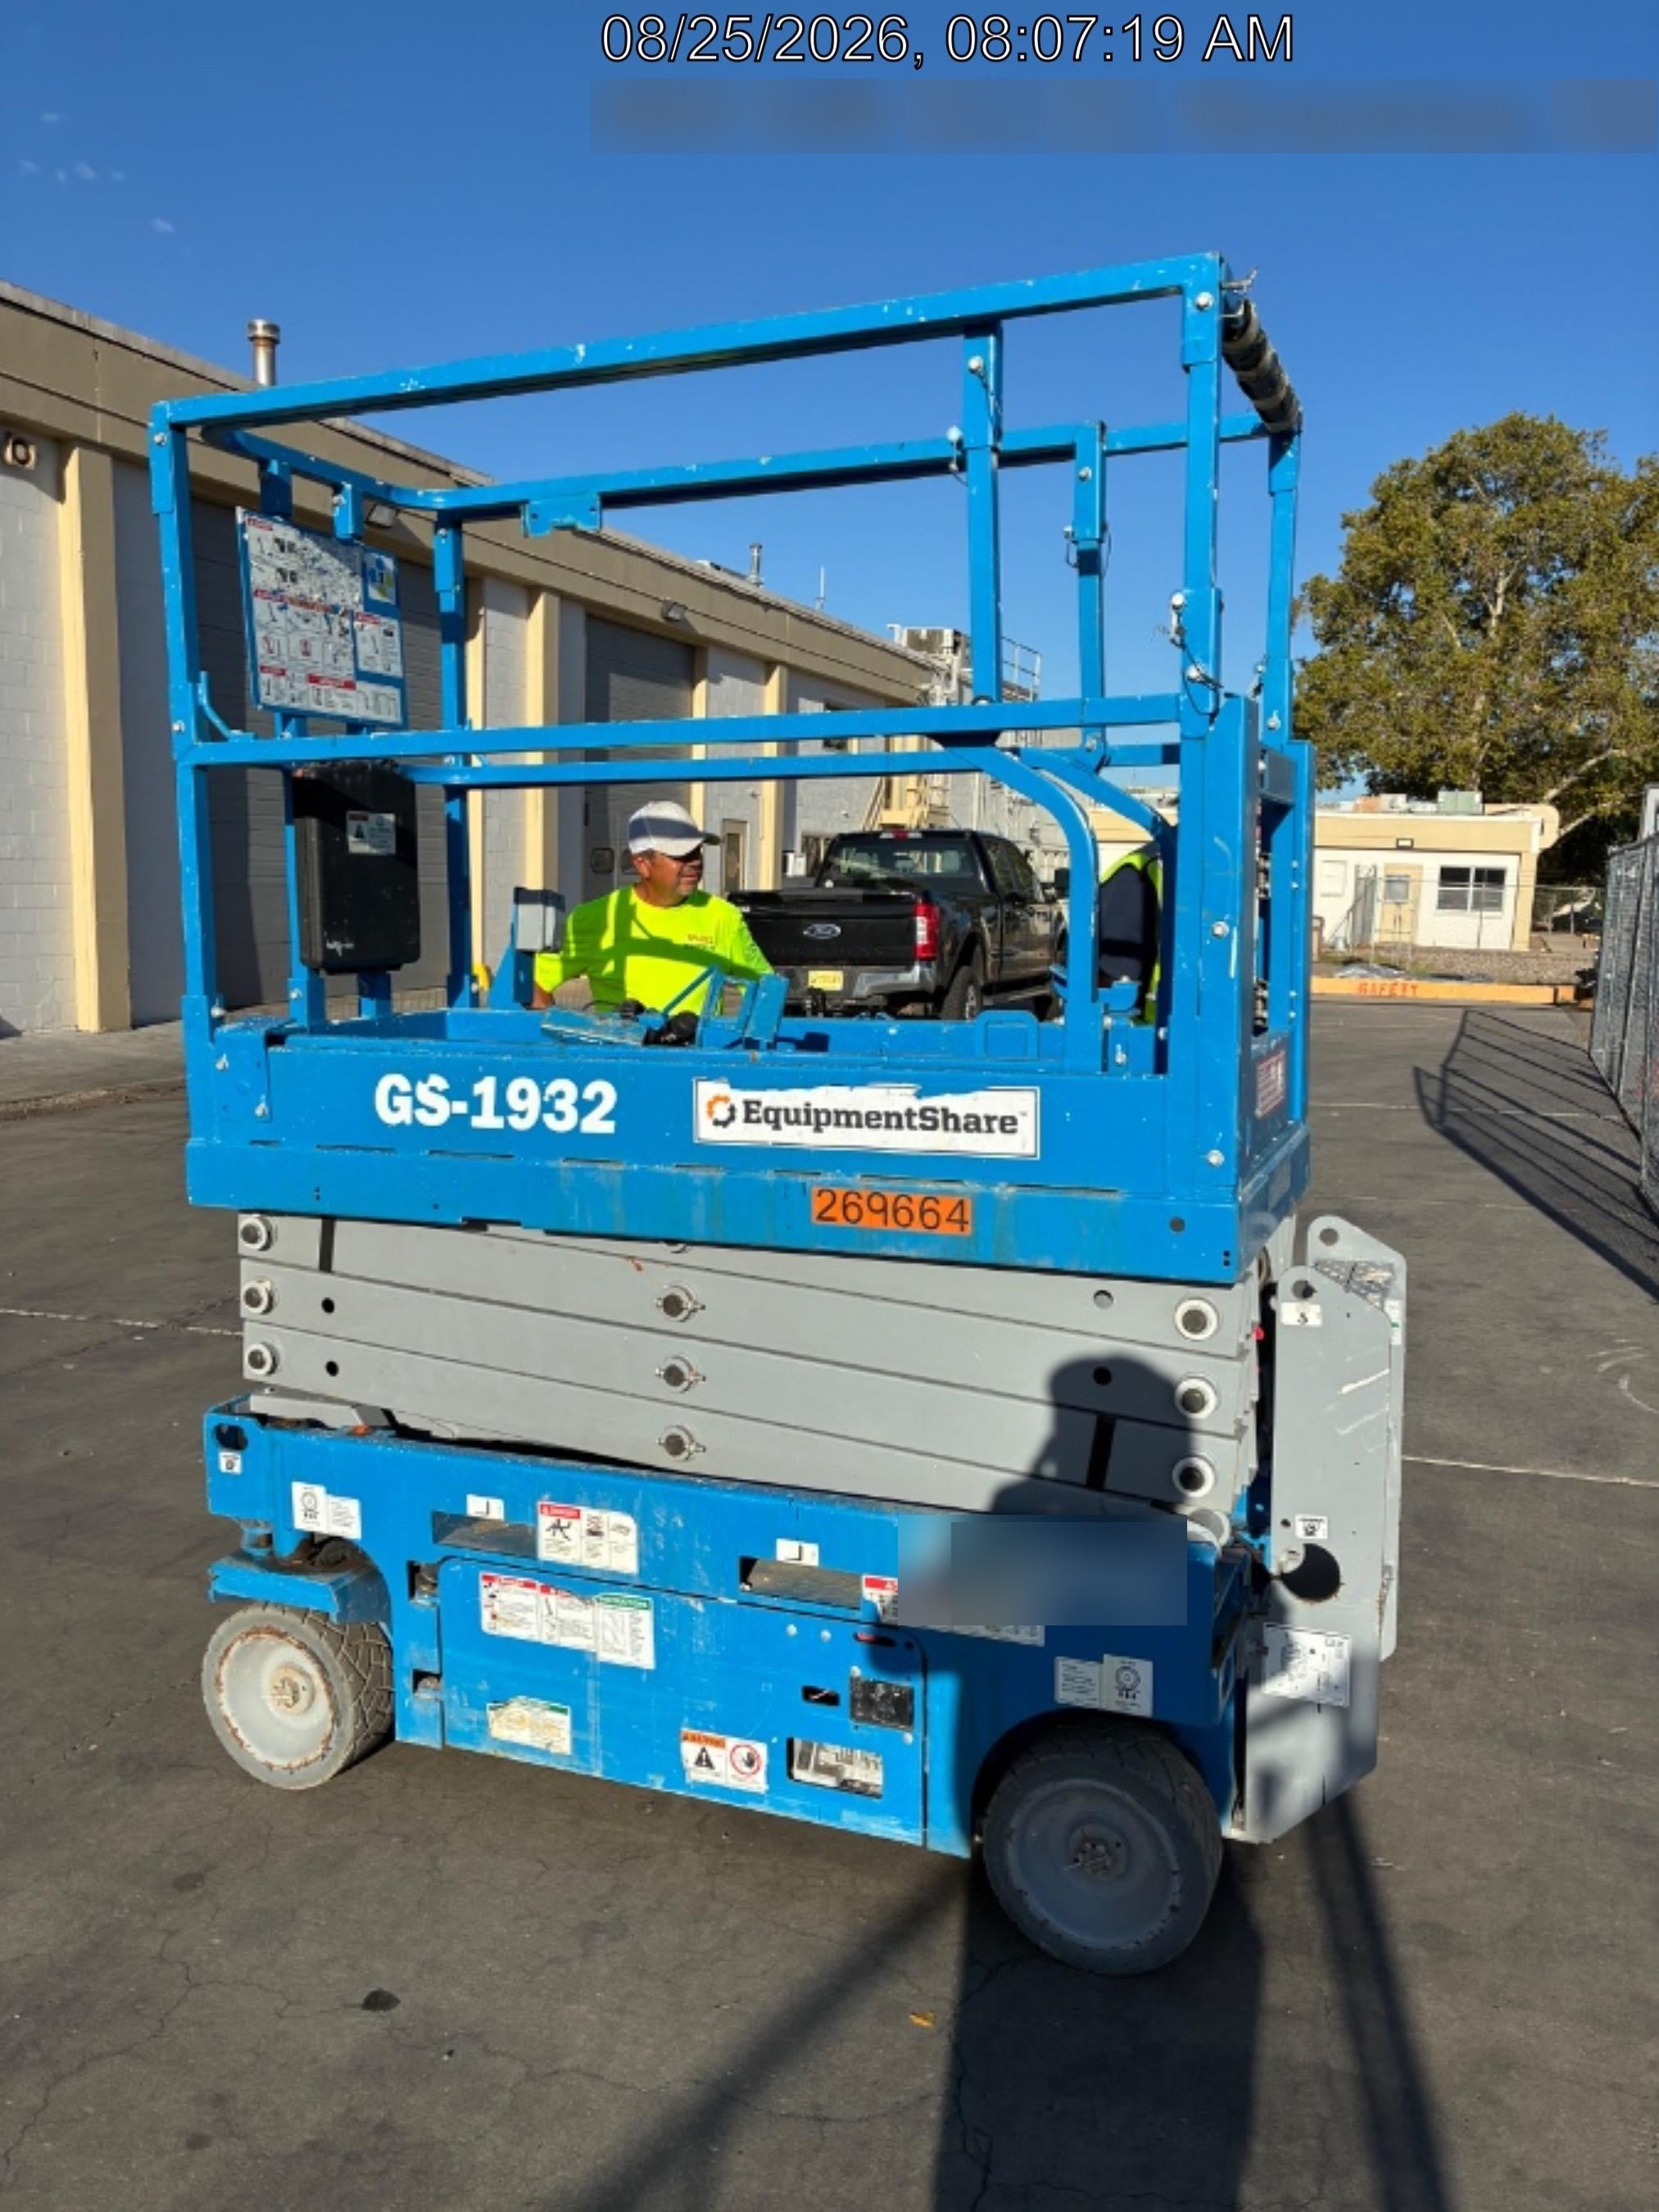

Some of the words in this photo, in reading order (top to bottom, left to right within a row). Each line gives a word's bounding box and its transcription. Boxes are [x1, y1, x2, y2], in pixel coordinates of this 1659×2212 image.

[374, 1073, 617, 1134] GS-1932
[743, 1099, 1018, 1134] EquipmentShare
[816, 1189, 969, 1231] 269664
